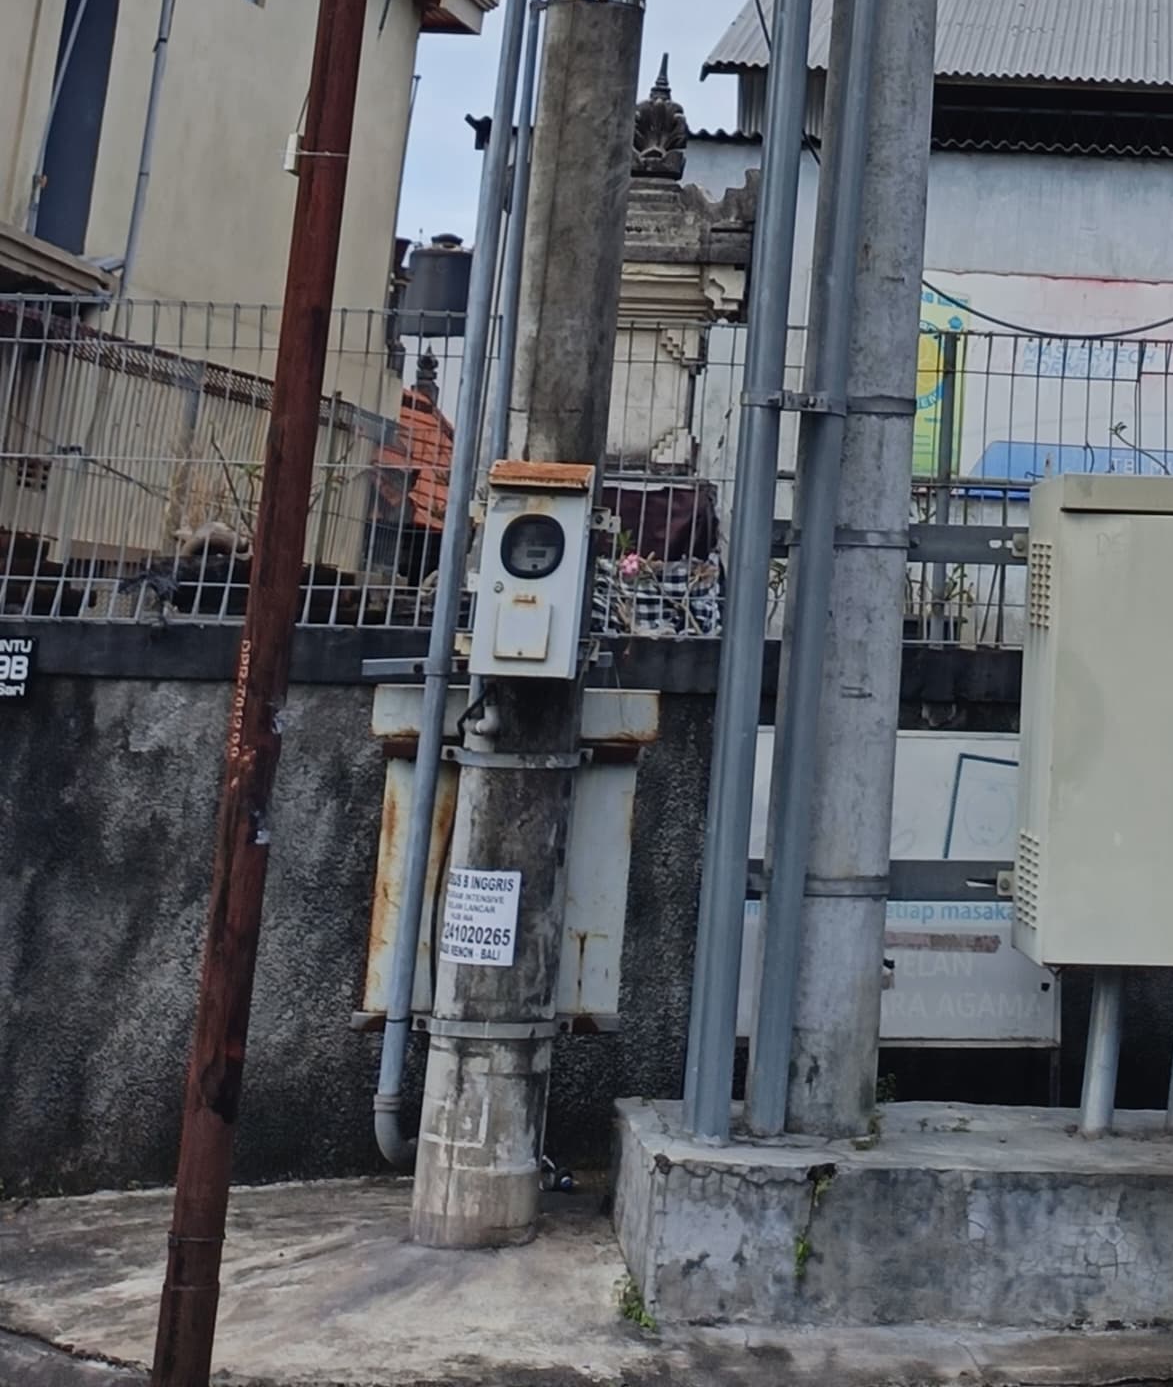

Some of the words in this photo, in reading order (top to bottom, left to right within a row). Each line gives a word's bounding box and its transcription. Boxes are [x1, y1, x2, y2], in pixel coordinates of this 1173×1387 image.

[1023, 344, 1156, 364] MASTERTECH
[470, 876, 515, 892] INGGRIS
[480, 949, 500, 961] BALI
